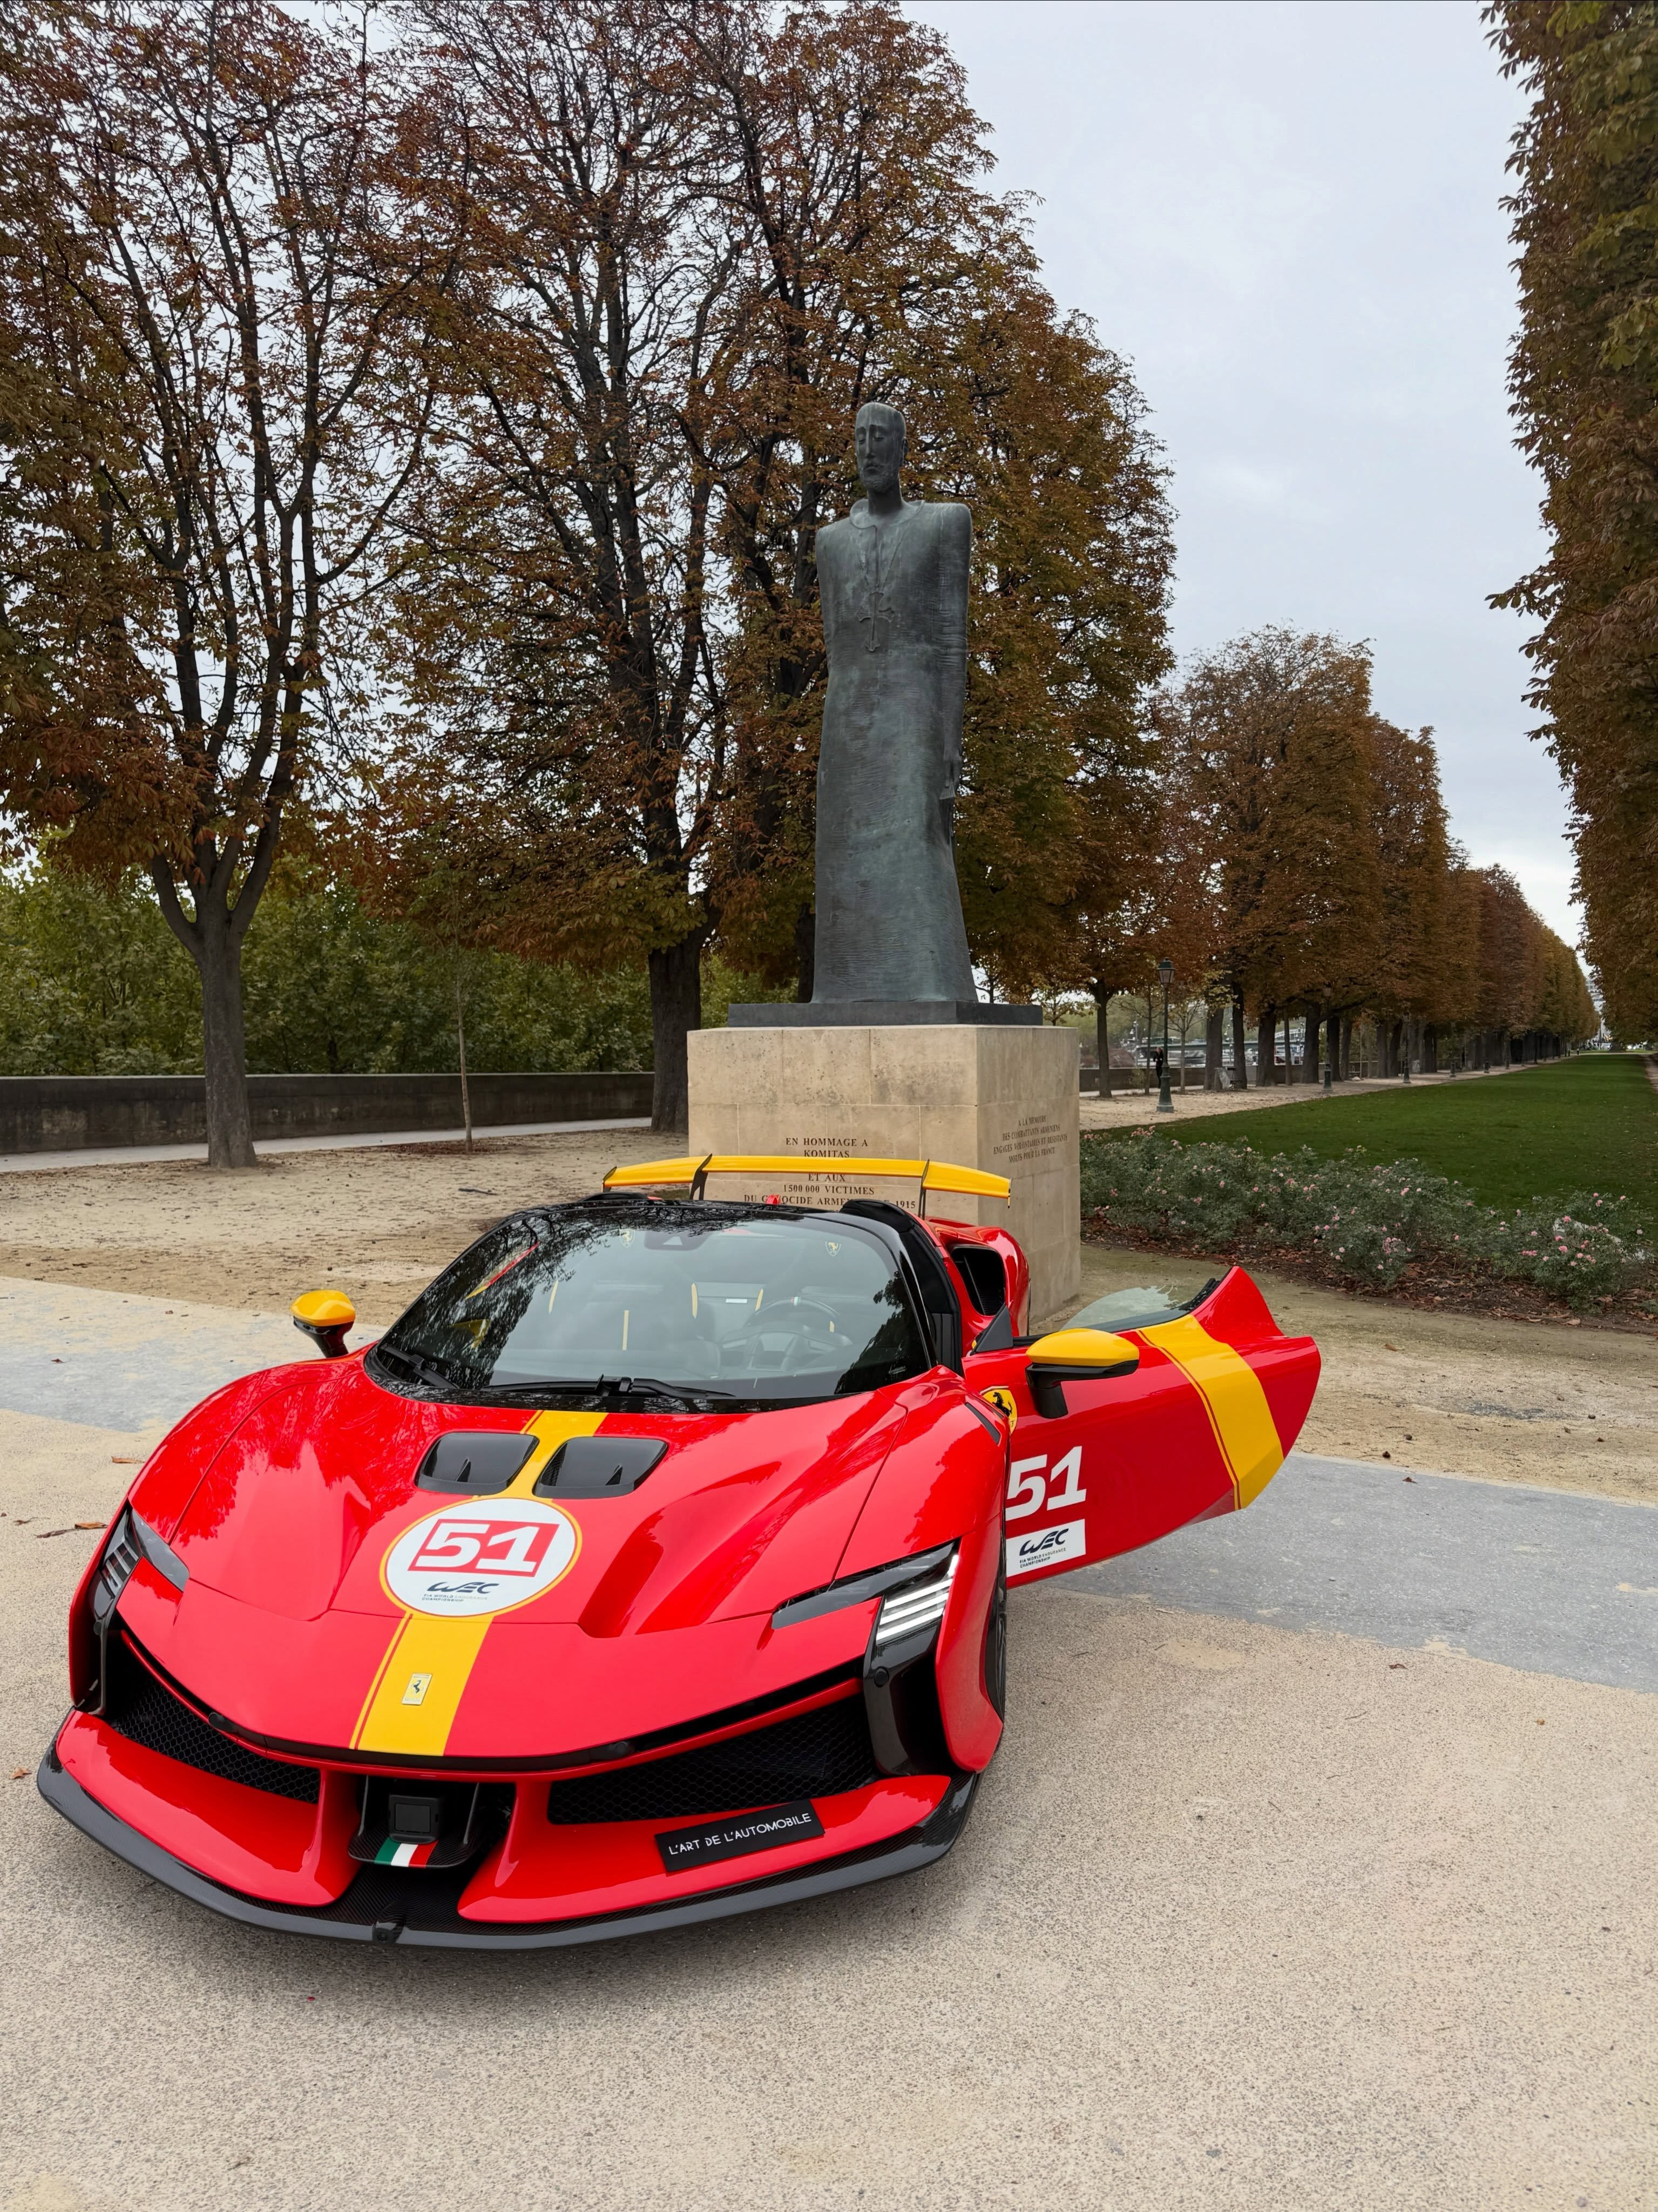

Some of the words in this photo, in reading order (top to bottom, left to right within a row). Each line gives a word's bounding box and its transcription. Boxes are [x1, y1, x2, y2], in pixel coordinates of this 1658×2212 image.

[1023, 1118, 1028, 1126] LA
[803, 1138, 857, 1147] HOMMAGE
[804, 1150, 850, 1158] KOMITAS
[993, 1144, 1012, 1155] ENGAGES
[1009, 1154, 1023, 1163] MORTS
[1024, 1150, 1034, 1159] POUR
[1041, 1147, 1055, 1156] FRANCE
[808, 1173, 821, 1181] ET
[806, 1185, 820, 1193] 000
[825, 1185, 875, 1195] VICTIMES
[762, 1195, 813, 1204] GOCIDE
[896, 1201, 915, 1209] 1915
[1005, 1446, 1087, 1521] 51
[415, 1522, 540, 1573] 51
[1019, 1528, 1069, 1556] WEC
[1042, 1547, 1066, 1557] ENDURANCE
[1020, 1556, 1051, 1568] CHAMPIONSHIP
[427, 1582, 500, 1594] WEC
[669, 1839, 700, 1855] L'ART
[705, 1835, 721, 1846] DE
[724, 1813, 812, 1842] L'AUTOMOBILE
